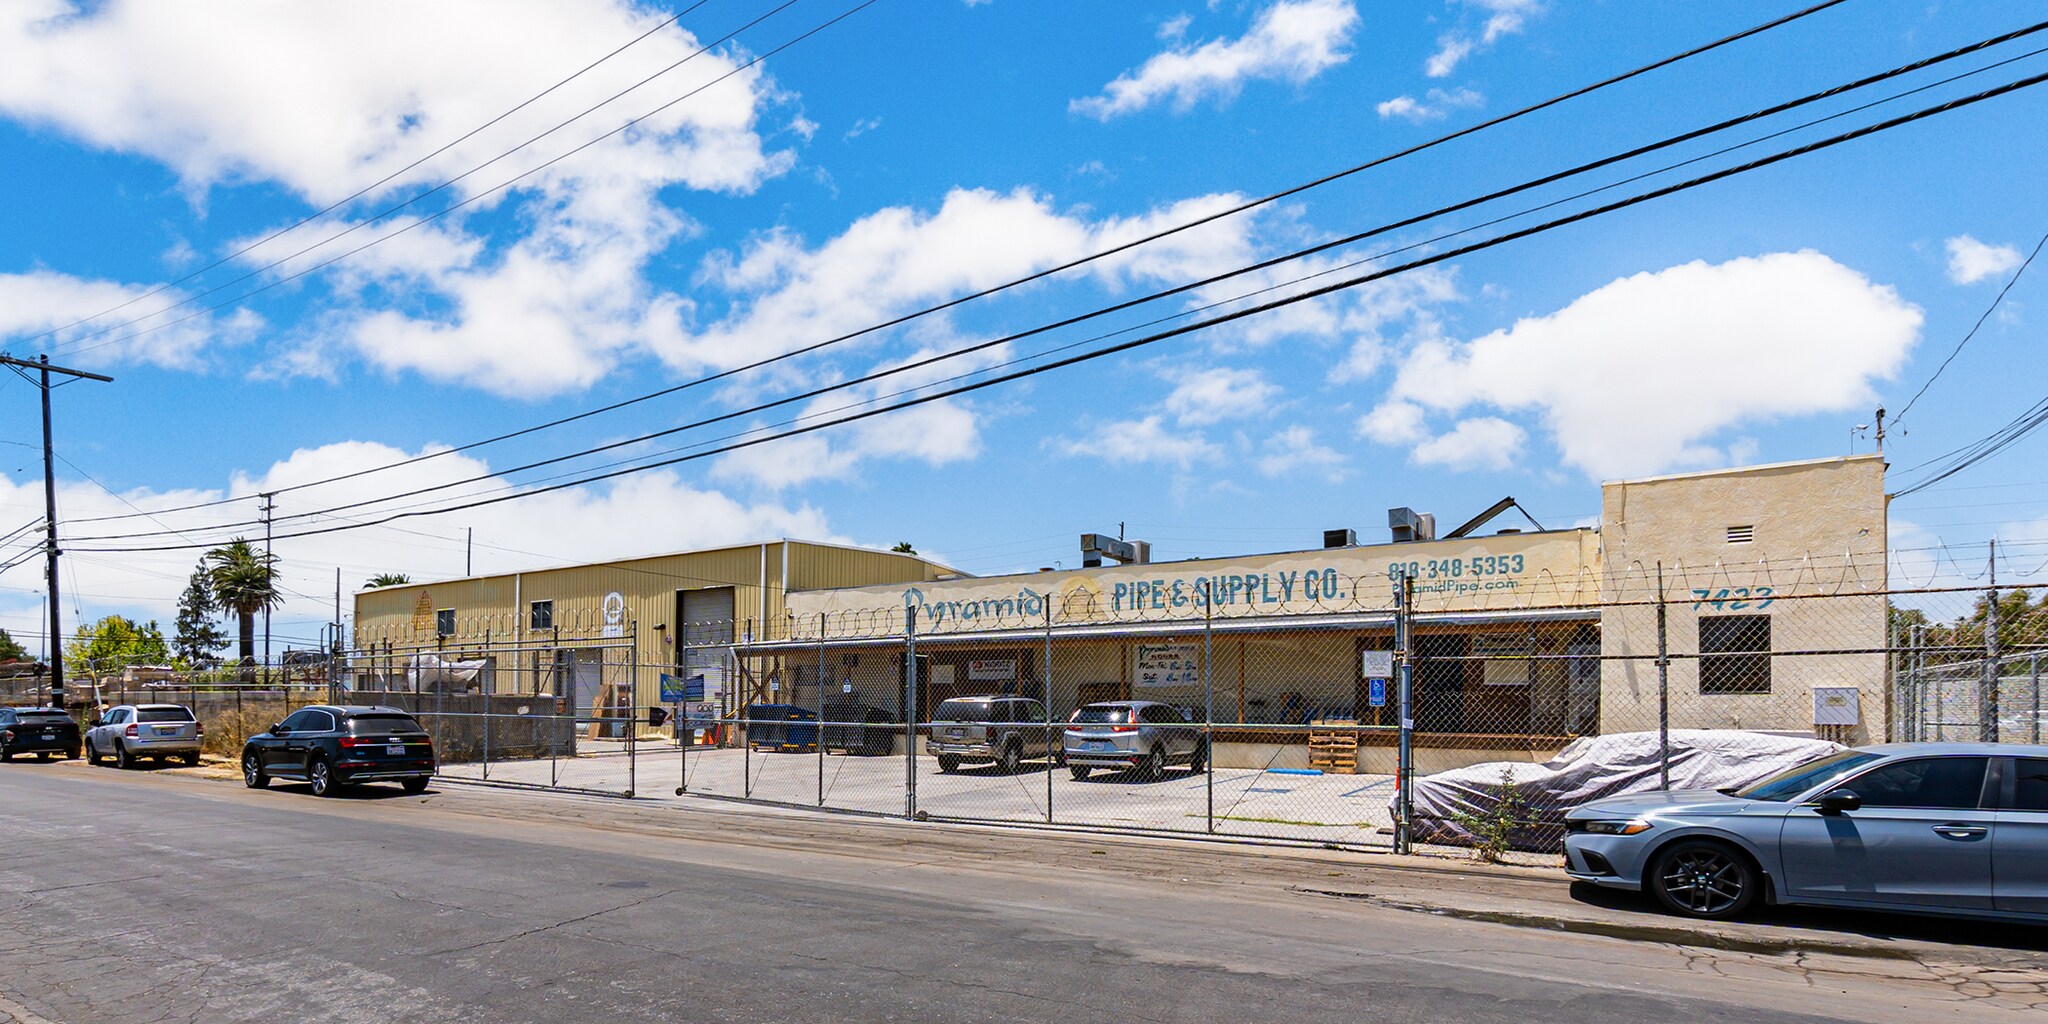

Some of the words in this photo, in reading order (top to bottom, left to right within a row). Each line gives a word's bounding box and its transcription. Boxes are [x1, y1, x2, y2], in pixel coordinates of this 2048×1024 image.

[1388, 554, 1525, 582] 818-348-5353
[901, 587, 1042, 634] Pyramid
[1114, 579, 1165, 611] PIPE
[1171, 579, 1190, 607] &
[1193, 570, 1298, 607] SUPPLY
[1304, 567, 1346, 599] CO.
[1692, 587, 1774, 611] 7423
